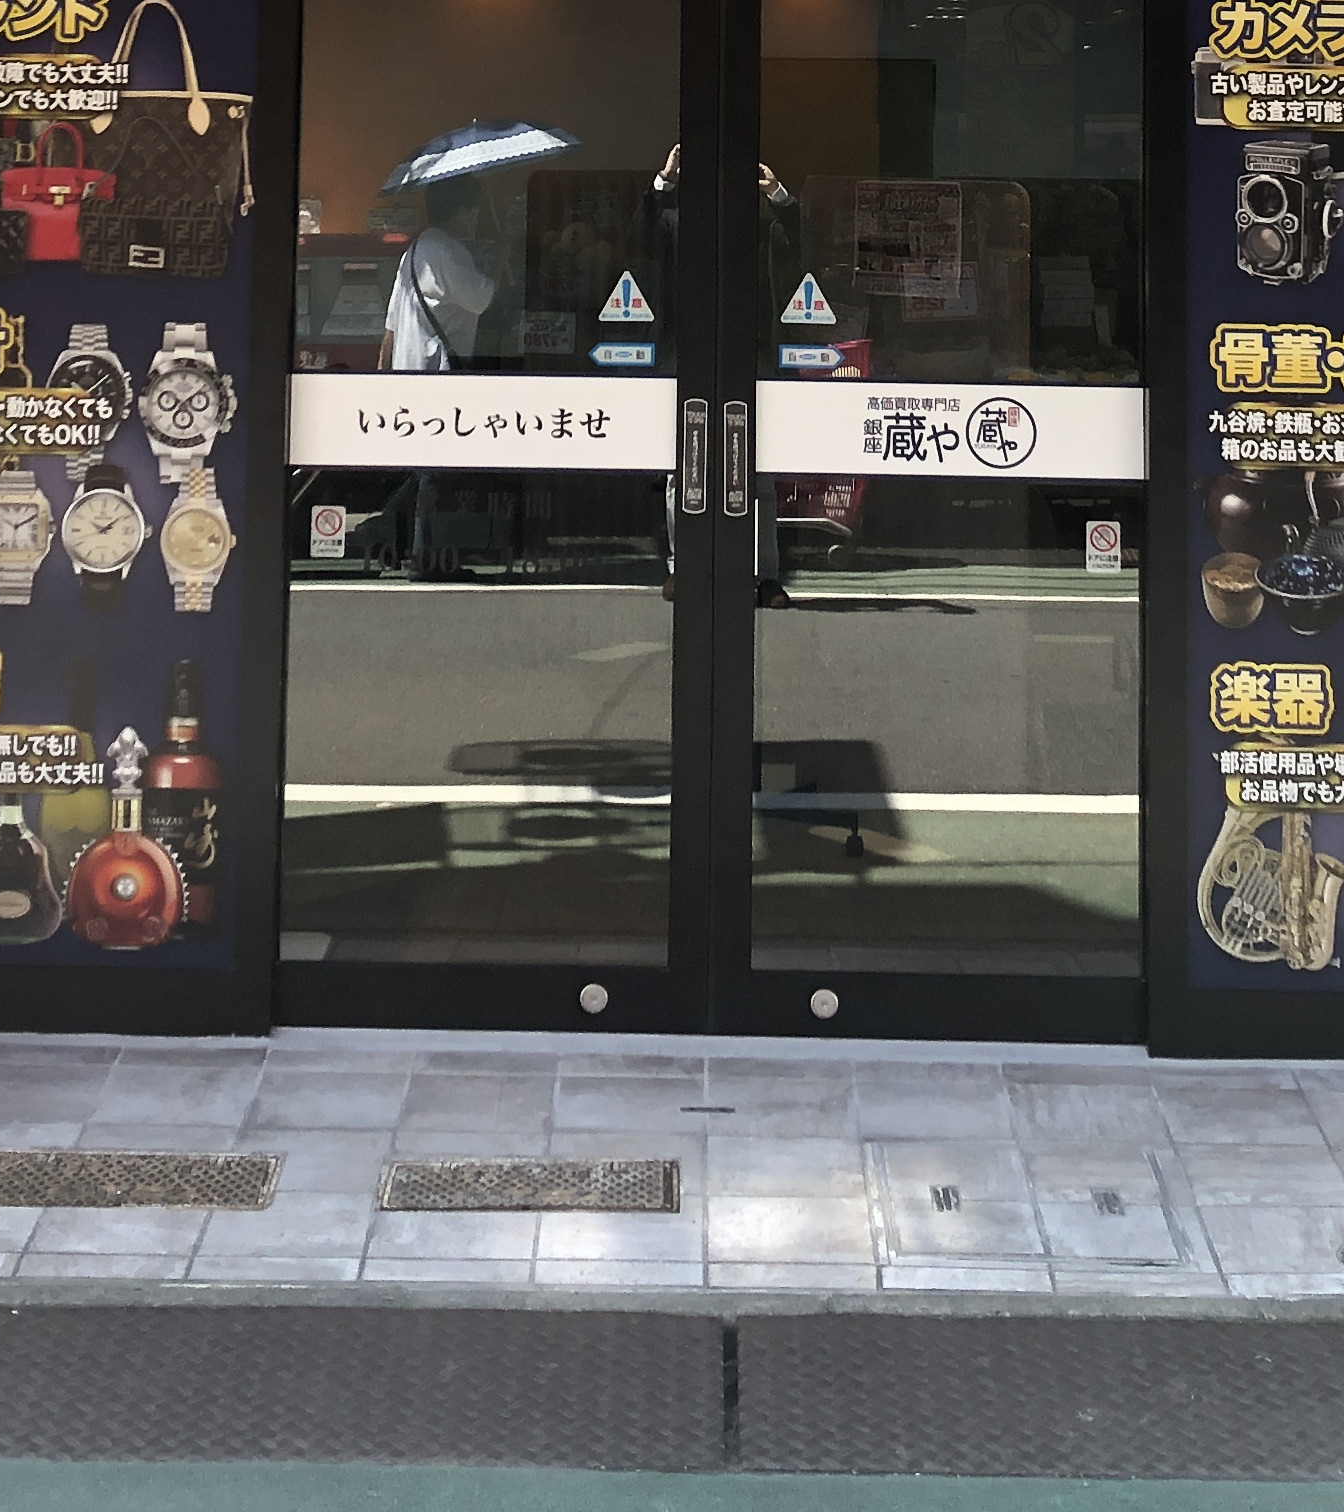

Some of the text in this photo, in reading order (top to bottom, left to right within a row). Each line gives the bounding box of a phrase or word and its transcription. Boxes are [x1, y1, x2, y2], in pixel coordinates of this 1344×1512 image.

[867, 397, 961, 412] 高価買取専門店
[357, 405, 611, 439] いらっしゃいませ
[1212, 663, 1333, 733] 楽器
